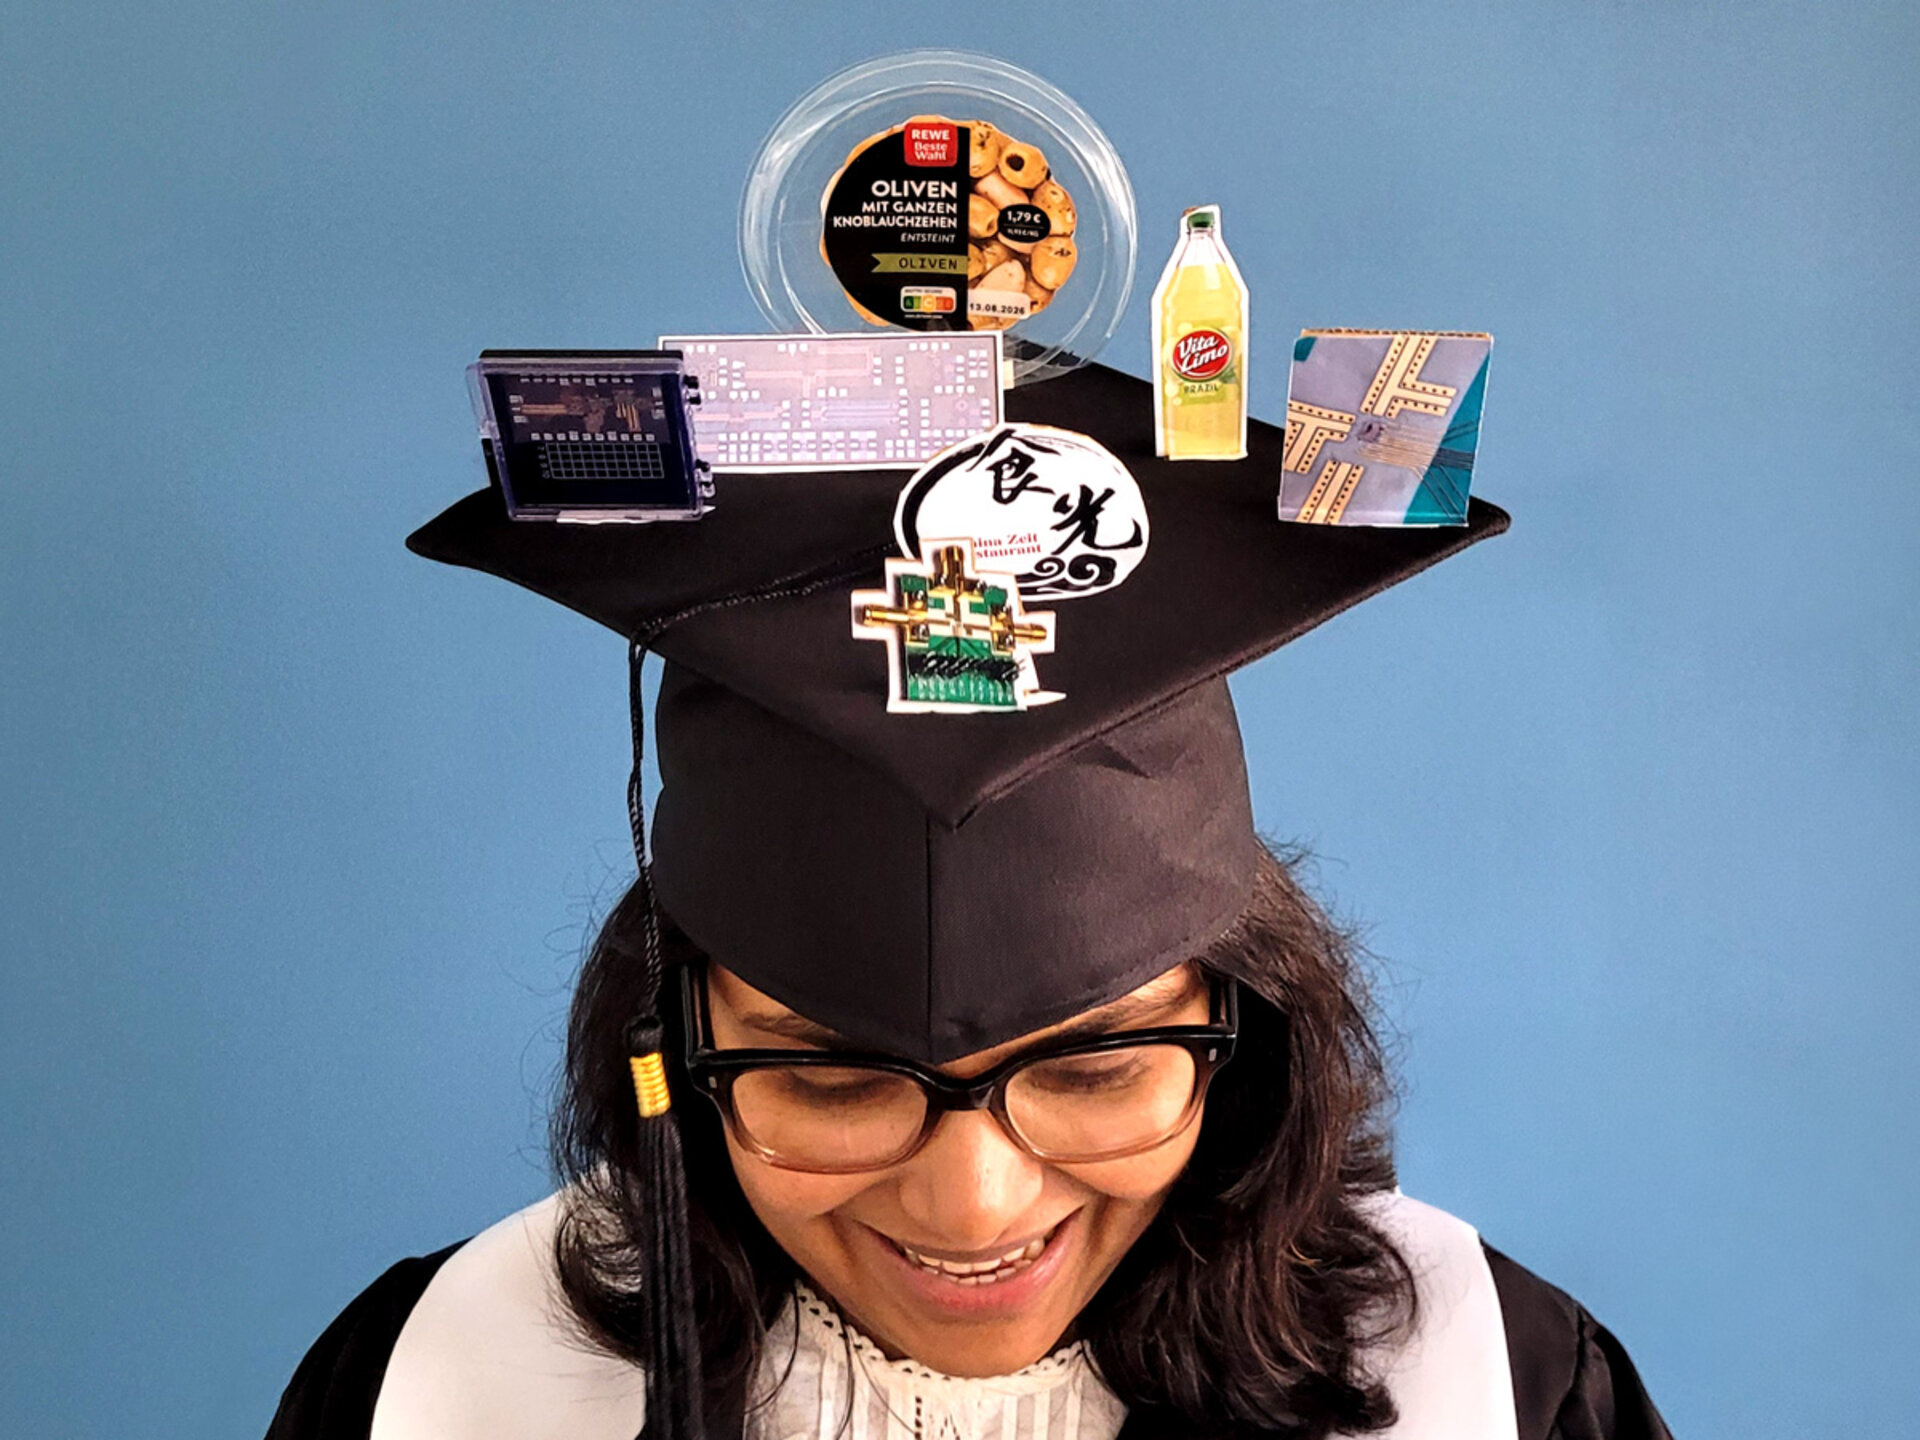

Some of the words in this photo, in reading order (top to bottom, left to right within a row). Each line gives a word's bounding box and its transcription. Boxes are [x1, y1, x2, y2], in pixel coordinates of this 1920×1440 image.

[911, 129, 951, 141] REWE
[914, 142, 948, 151] Beste
[915, 151, 946, 160] Wahl
[871, 180, 957, 198] OLIVEN
[862, 201, 889, 213] MIT
[893, 201, 957, 214] GANZEN
[833, 216, 957, 229] KNOBLAUCHZEHEN
[1007, 210, 1032, 223] 1,79
[901, 232, 956, 243] ENTSTEINT
[898, 257, 958, 269] OLIVEN
[1177, 335, 1220, 359] Vita
[1181, 344, 1228, 373] Limo
[1183, 384, 1219, 394] BRAZIL
[973, 536, 1002, 548] ina
[1007, 533, 1038, 545] Zeit
[976, 544, 1041, 558] staurant
